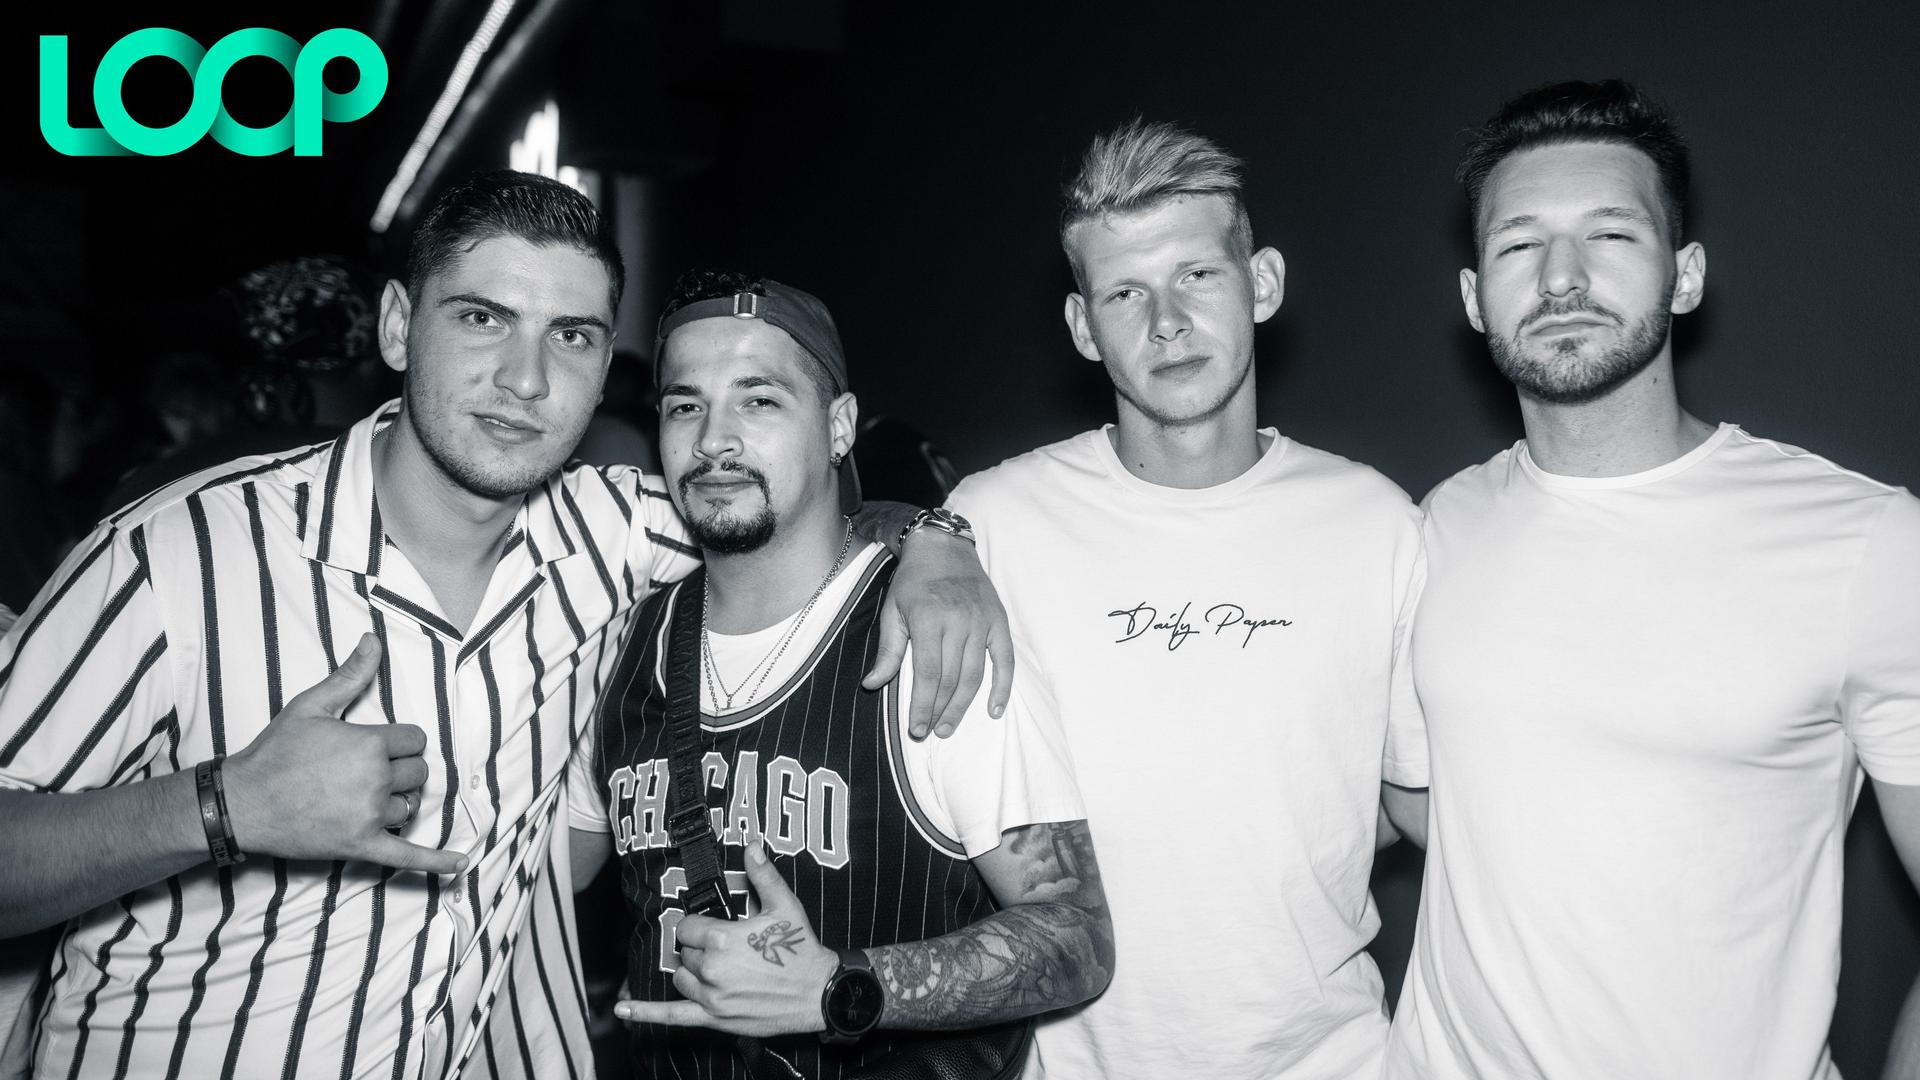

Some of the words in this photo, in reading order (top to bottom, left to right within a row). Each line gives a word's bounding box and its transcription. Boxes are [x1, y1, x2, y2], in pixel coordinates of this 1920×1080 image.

[1108, 601, 1200, 651] Daily
[1205, 604, 1293, 648] Paper
[608, 750, 850, 870] CHCAGO
